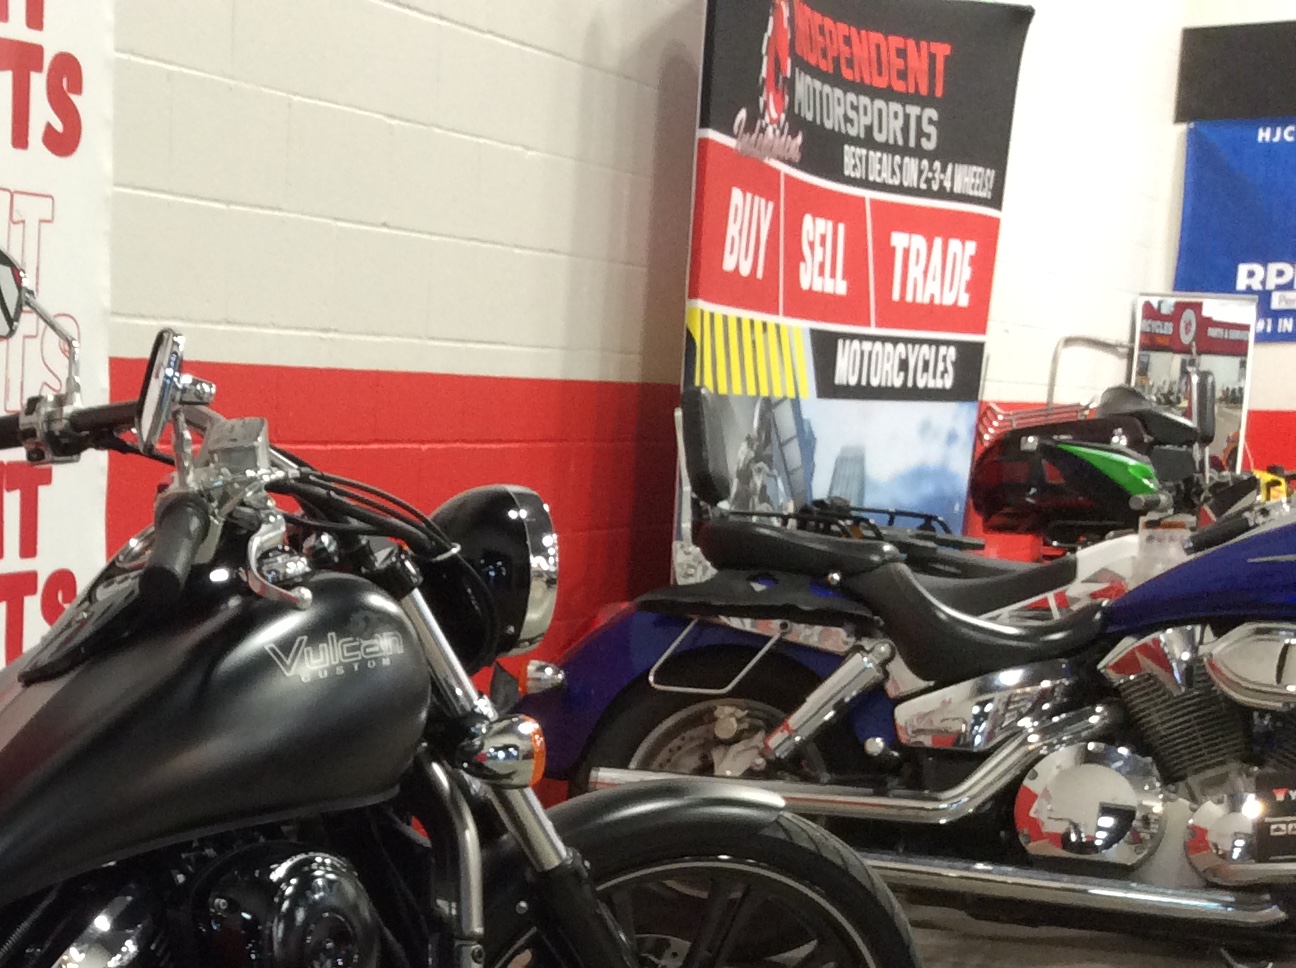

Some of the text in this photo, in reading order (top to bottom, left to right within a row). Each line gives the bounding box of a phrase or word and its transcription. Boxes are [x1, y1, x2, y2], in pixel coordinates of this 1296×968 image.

[794, 67, 940, 151] MOTORSPORTS
[843, 144, 867, 179] BEST
[868, 149, 901, 186] DEALS
[902, 156, 919, 188] ON
[919, 158, 953, 193] 2-3-4
[722, 186, 774, 280] BUY
[799, 213, 847, 296] SELL
[890, 231, 977, 308] TRADE
[1235, 262, 1296, 291] RP
[1277, 316, 1293, 332] IN
[834, 338, 957, 390] MOTORCYCLES
[263, 631, 404, 677] Vulcan
